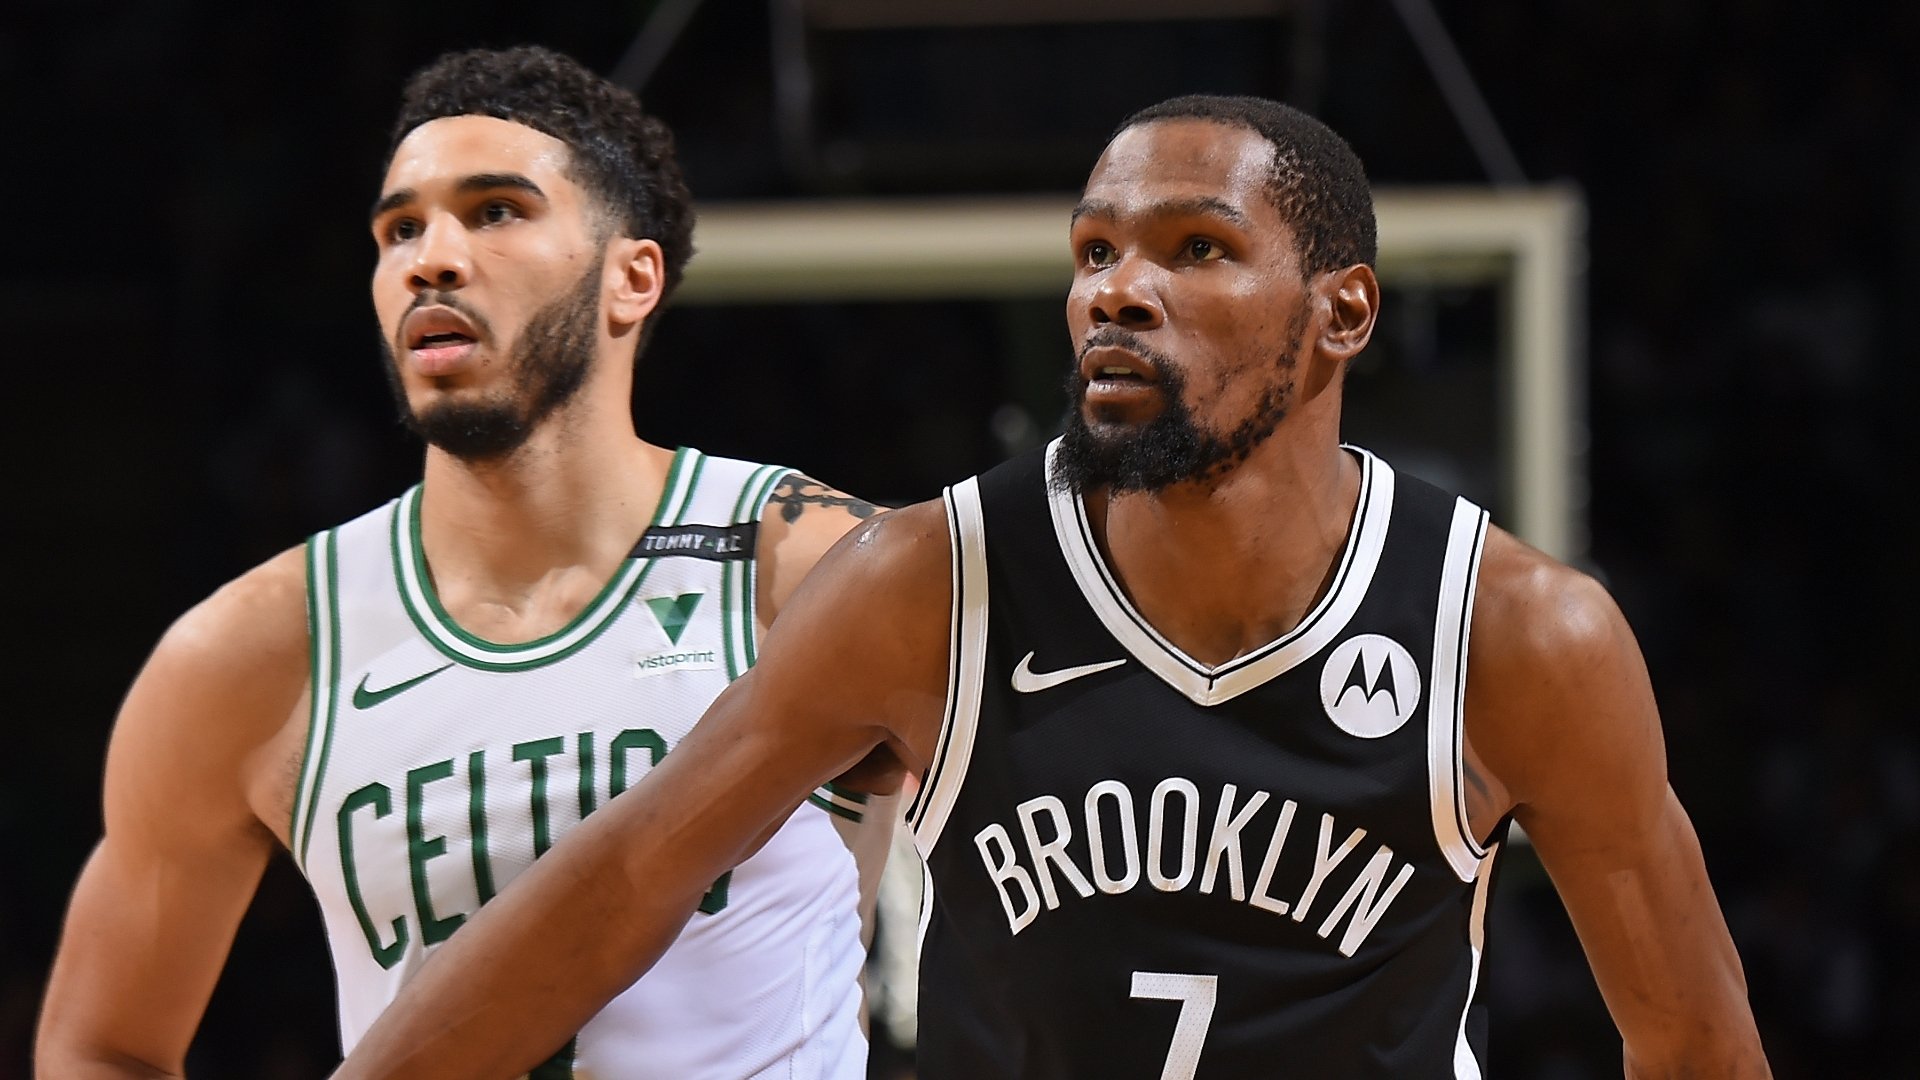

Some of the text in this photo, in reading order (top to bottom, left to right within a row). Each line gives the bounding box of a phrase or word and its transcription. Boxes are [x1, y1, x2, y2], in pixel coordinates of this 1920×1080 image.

[645, 533, 705, 551] TOMMY
[637, 650, 715, 669] vistaprint
[337, 728, 734, 970] CELT
[973, 777, 1415, 958] BROOKLYN
[1130, 971, 1218, 1080] 7
